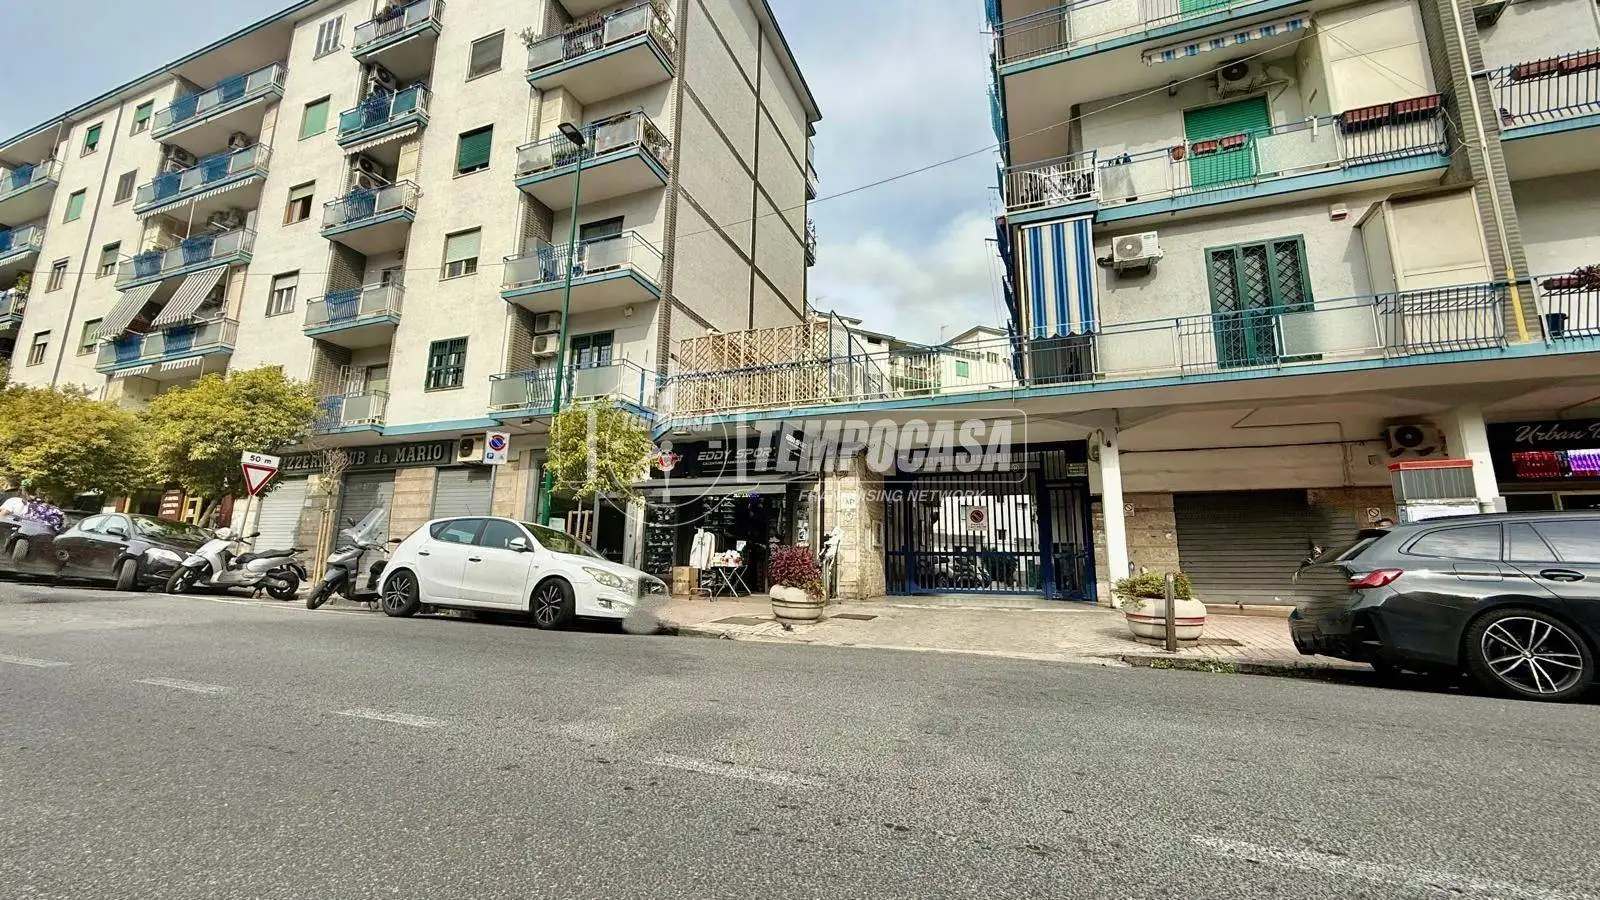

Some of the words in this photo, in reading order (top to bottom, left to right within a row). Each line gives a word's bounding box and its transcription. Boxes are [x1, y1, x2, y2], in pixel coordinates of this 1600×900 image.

[1515, 423, 1587, 444] Urban
[250, 454, 261, 463] 50
[280, 453, 330, 470] IZZERI
[342, 451, 366, 465] UB
[374, 450, 388, 464] da
[394, 444, 442, 462] MARIO
[697, 449, 732, 461] EDDY
[736, 447, 778, 459] SPOR
